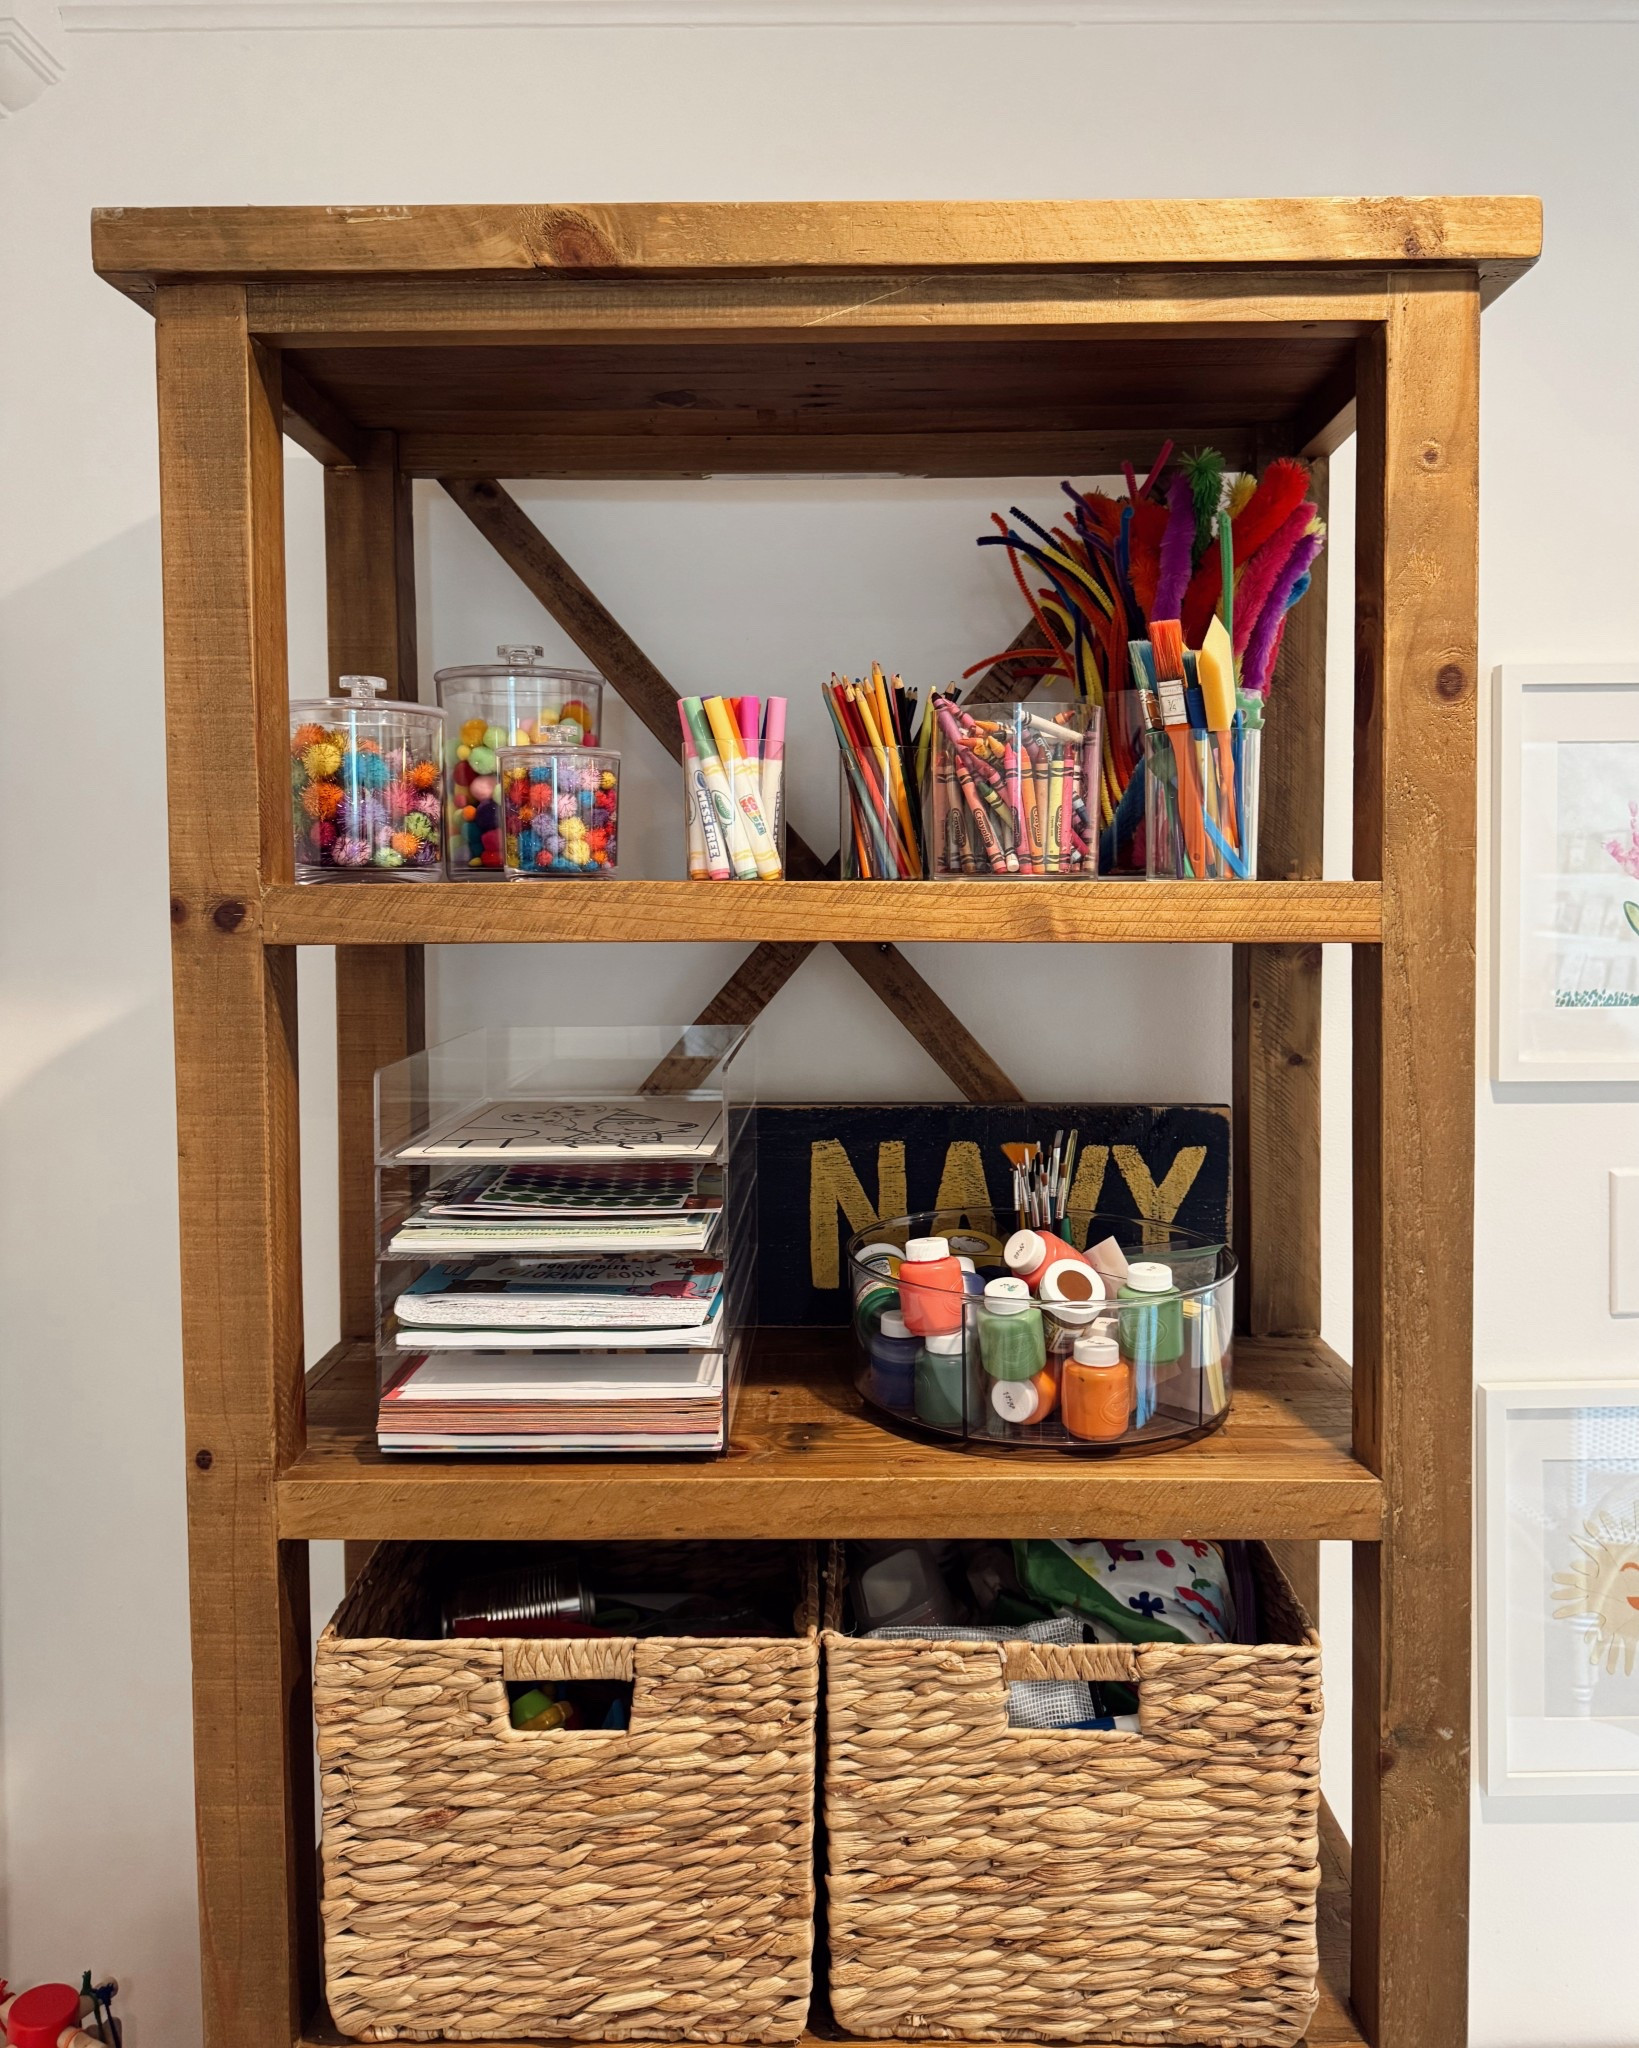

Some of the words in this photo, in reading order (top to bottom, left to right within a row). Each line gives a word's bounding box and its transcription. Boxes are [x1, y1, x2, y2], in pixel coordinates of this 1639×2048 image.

[697, 789, 714, 825] MESS
[703, 822, 720, 859] FREE
[974, 808, 993, 845] Crayola
[1032, 808, 1041, 844] Crayola
[497, 1267, 600, 1280] COLORING
[606, 1269, 661, 1279] BOOK
